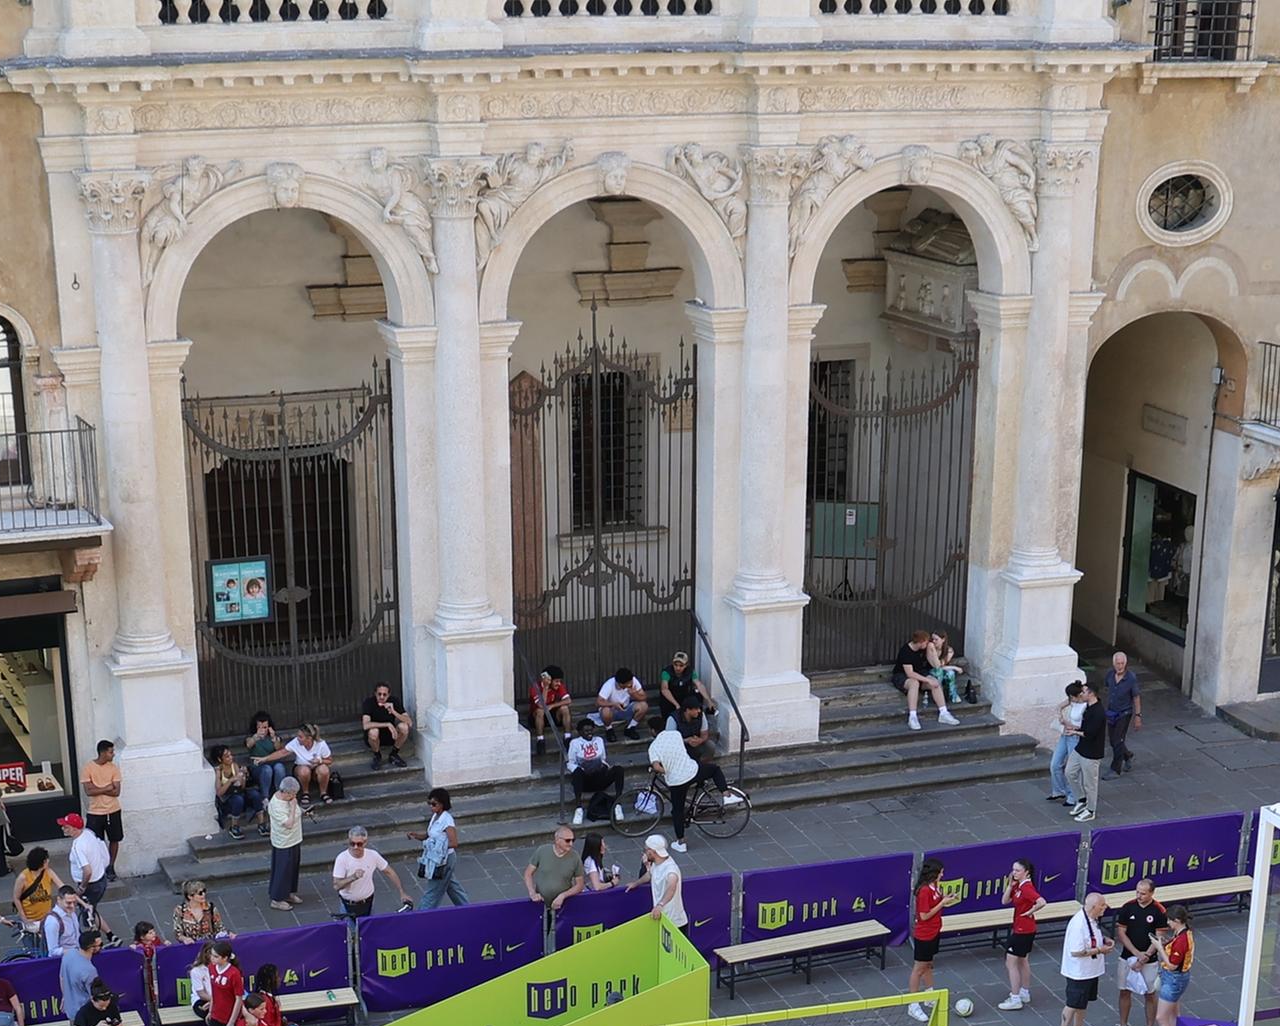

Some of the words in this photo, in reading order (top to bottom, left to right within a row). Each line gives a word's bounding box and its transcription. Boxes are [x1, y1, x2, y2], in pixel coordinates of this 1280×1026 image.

[1104, 861, 1135, 881] hero
[1142, 854, 1174, 879] park
[761, 904, 794, 925] hero
[802, 897, 837, 922] park
[381, 952, 417, 972] hero
[426, 944, 464, 970] park
[29, 996, 61, 1019] ark
[531, 984, 577, 1013] hero
